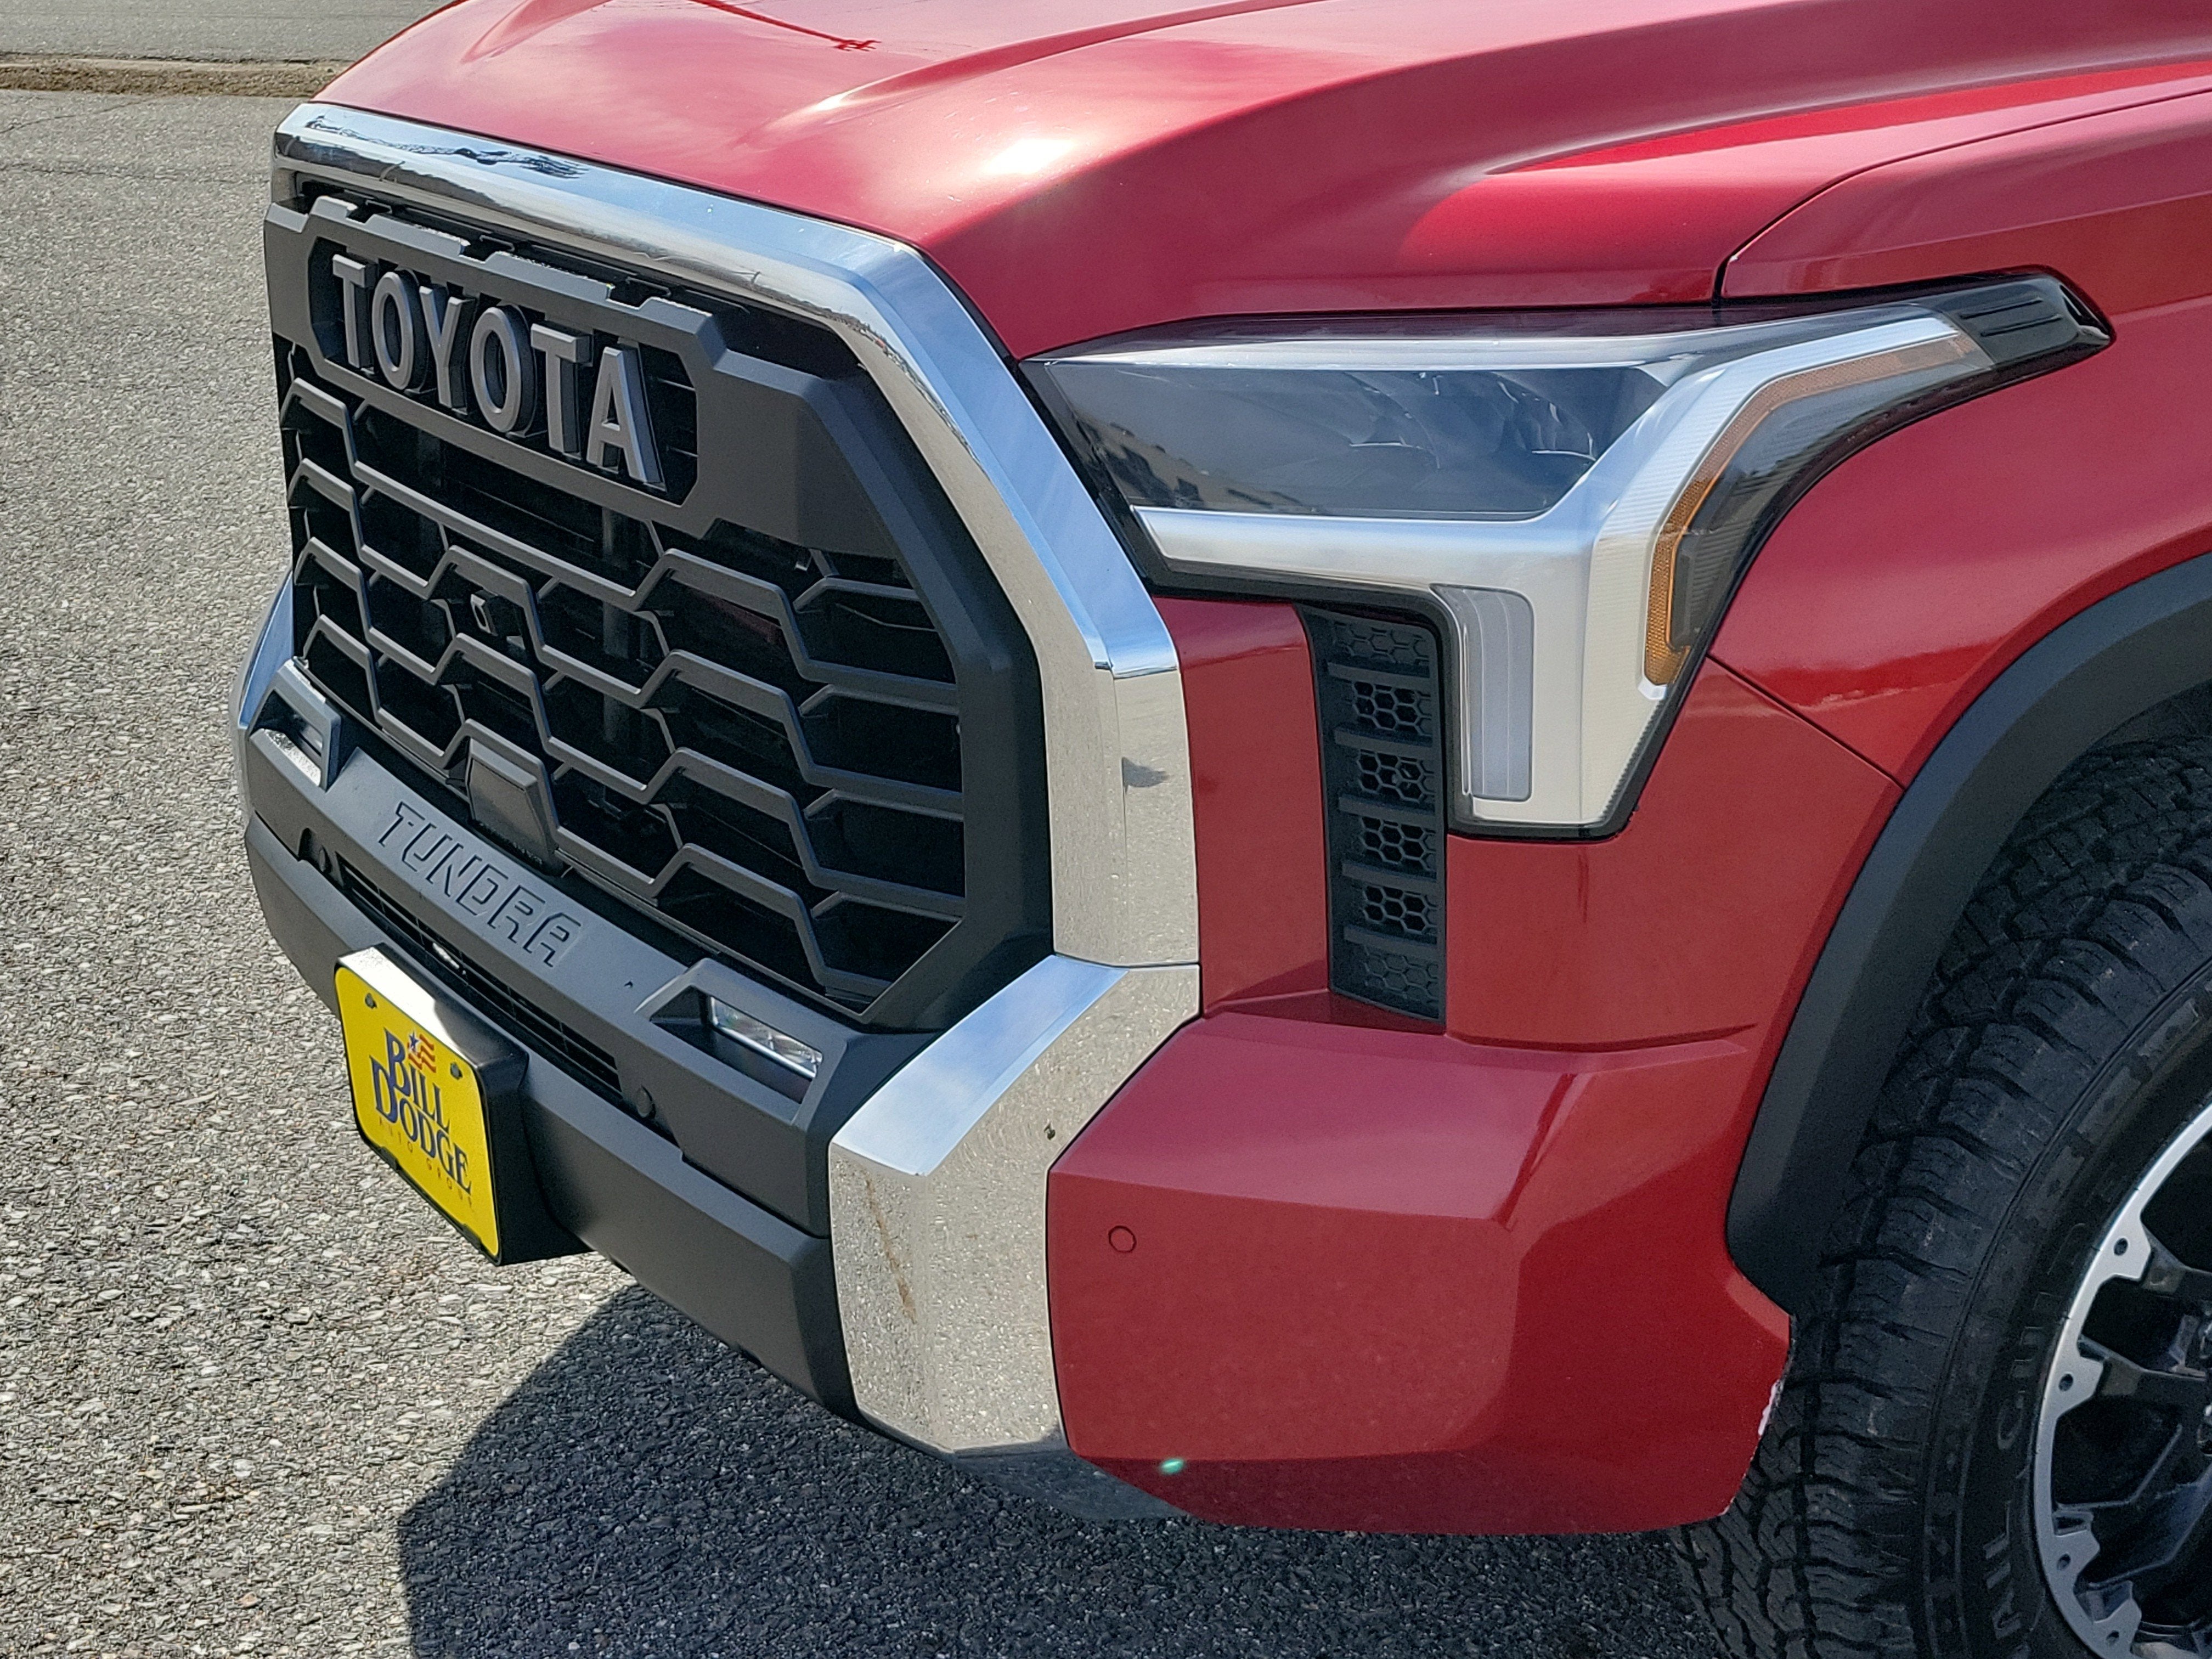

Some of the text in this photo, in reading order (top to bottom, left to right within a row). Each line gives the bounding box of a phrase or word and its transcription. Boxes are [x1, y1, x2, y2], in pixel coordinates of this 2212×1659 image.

[332, 253, 664, 490] TOYOTA
[378, 800, 583, 968] TUNDRA
[369, 1055, 472, 1195] DODGE
[383, 1026, 450, 1133] BILL
